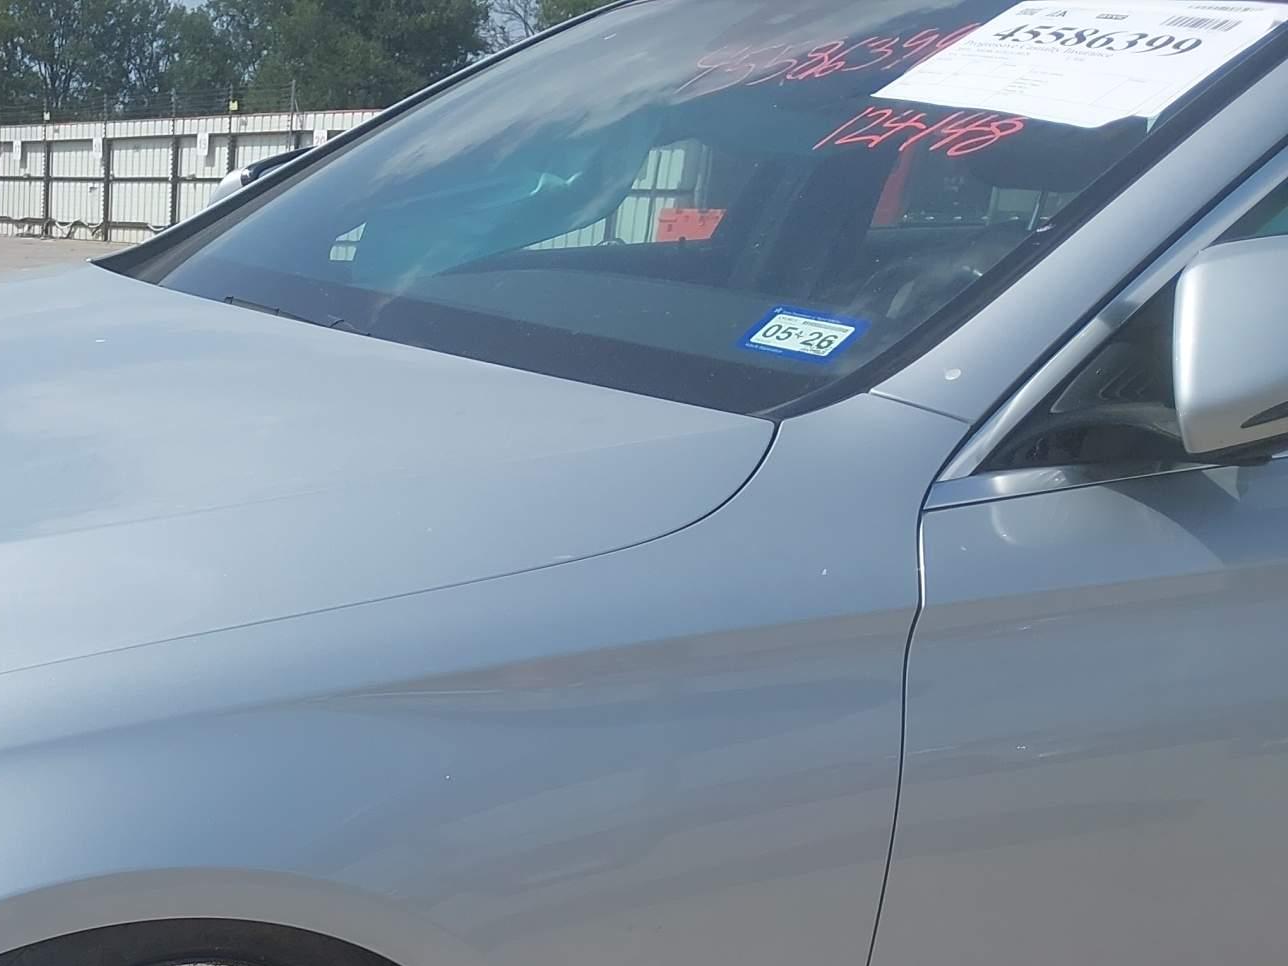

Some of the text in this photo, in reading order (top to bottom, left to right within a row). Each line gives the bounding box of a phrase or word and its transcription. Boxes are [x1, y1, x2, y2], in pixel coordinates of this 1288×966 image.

[992, 24, 1202, 57] 45586399
[762, 324, 798, 341] 05
[800, 331, 838, 350] 26
